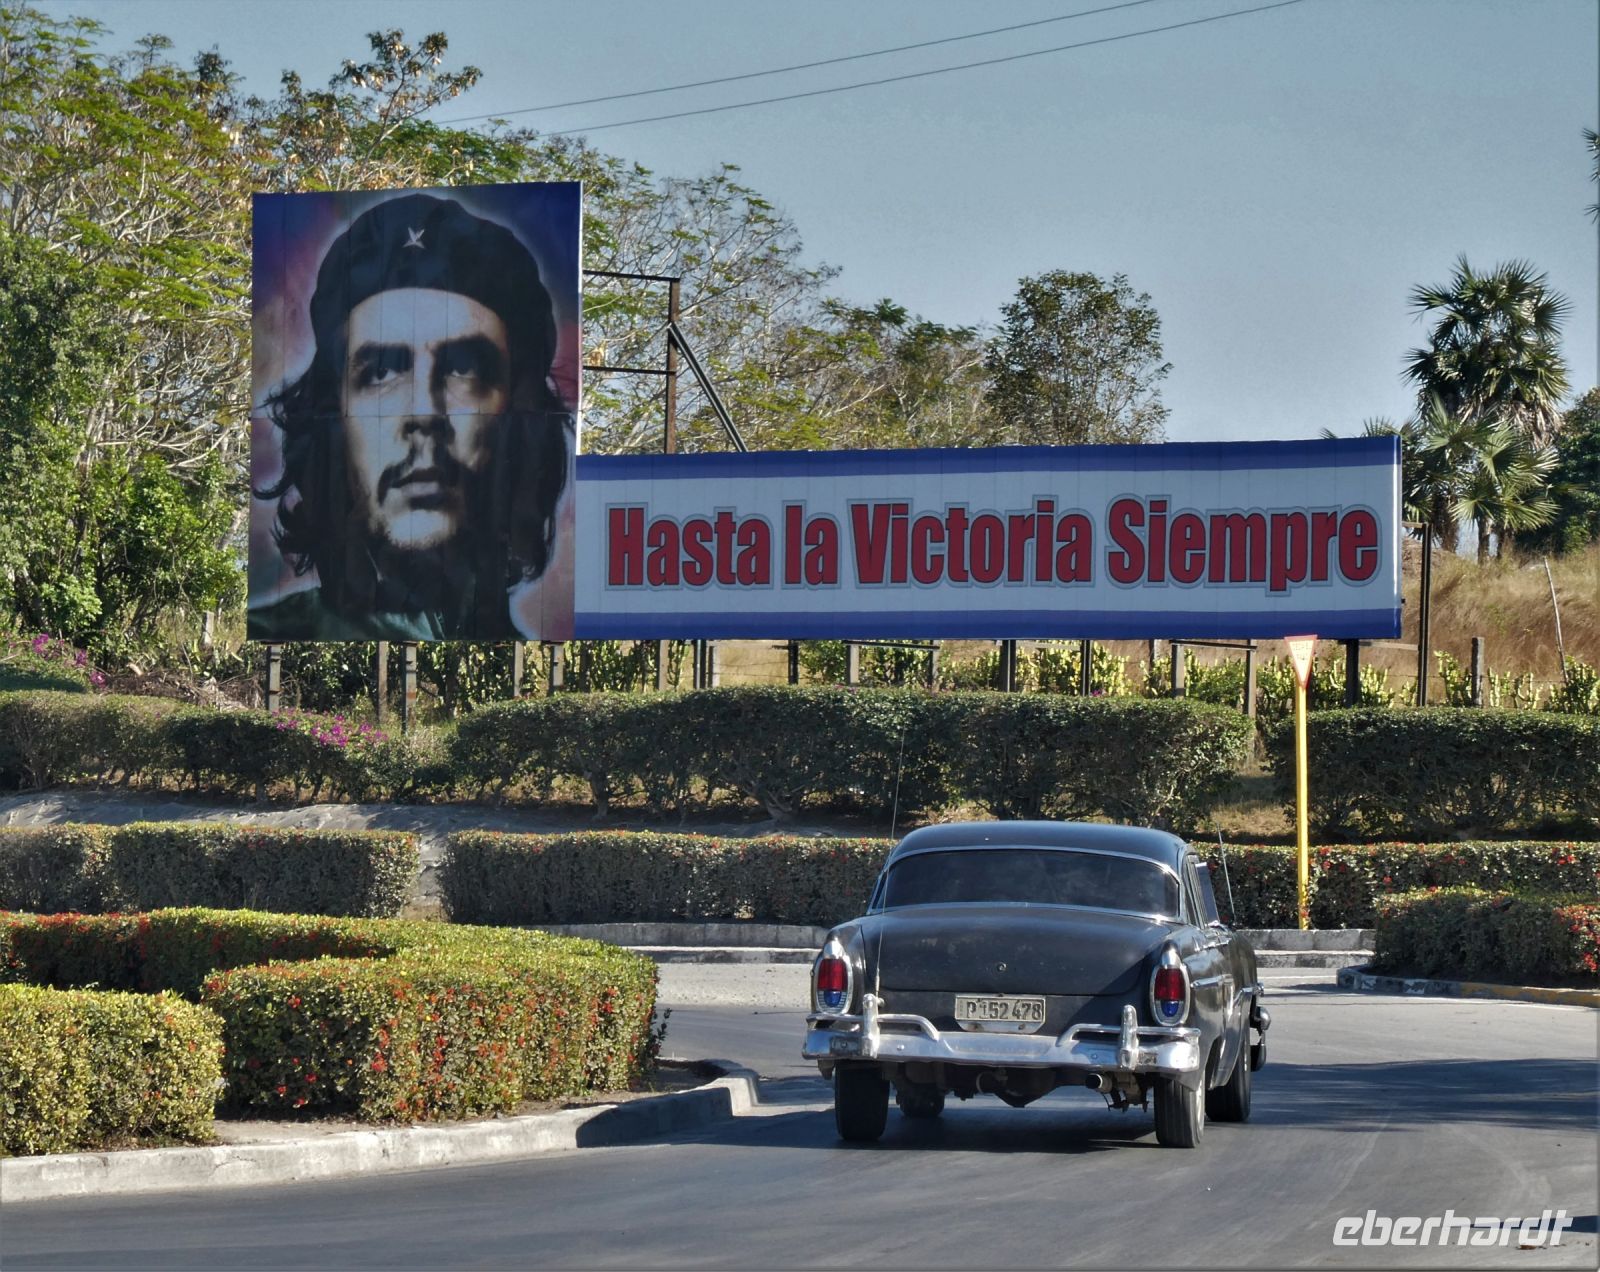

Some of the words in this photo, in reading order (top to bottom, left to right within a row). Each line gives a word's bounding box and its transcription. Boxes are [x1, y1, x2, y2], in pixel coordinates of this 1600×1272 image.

[608, 507, 770, 586] Hasta
[784, 505, 839, 585] la
[850, 500, 1093, 585] Victoria
[1107, 498, 1379, 592] Siempre
